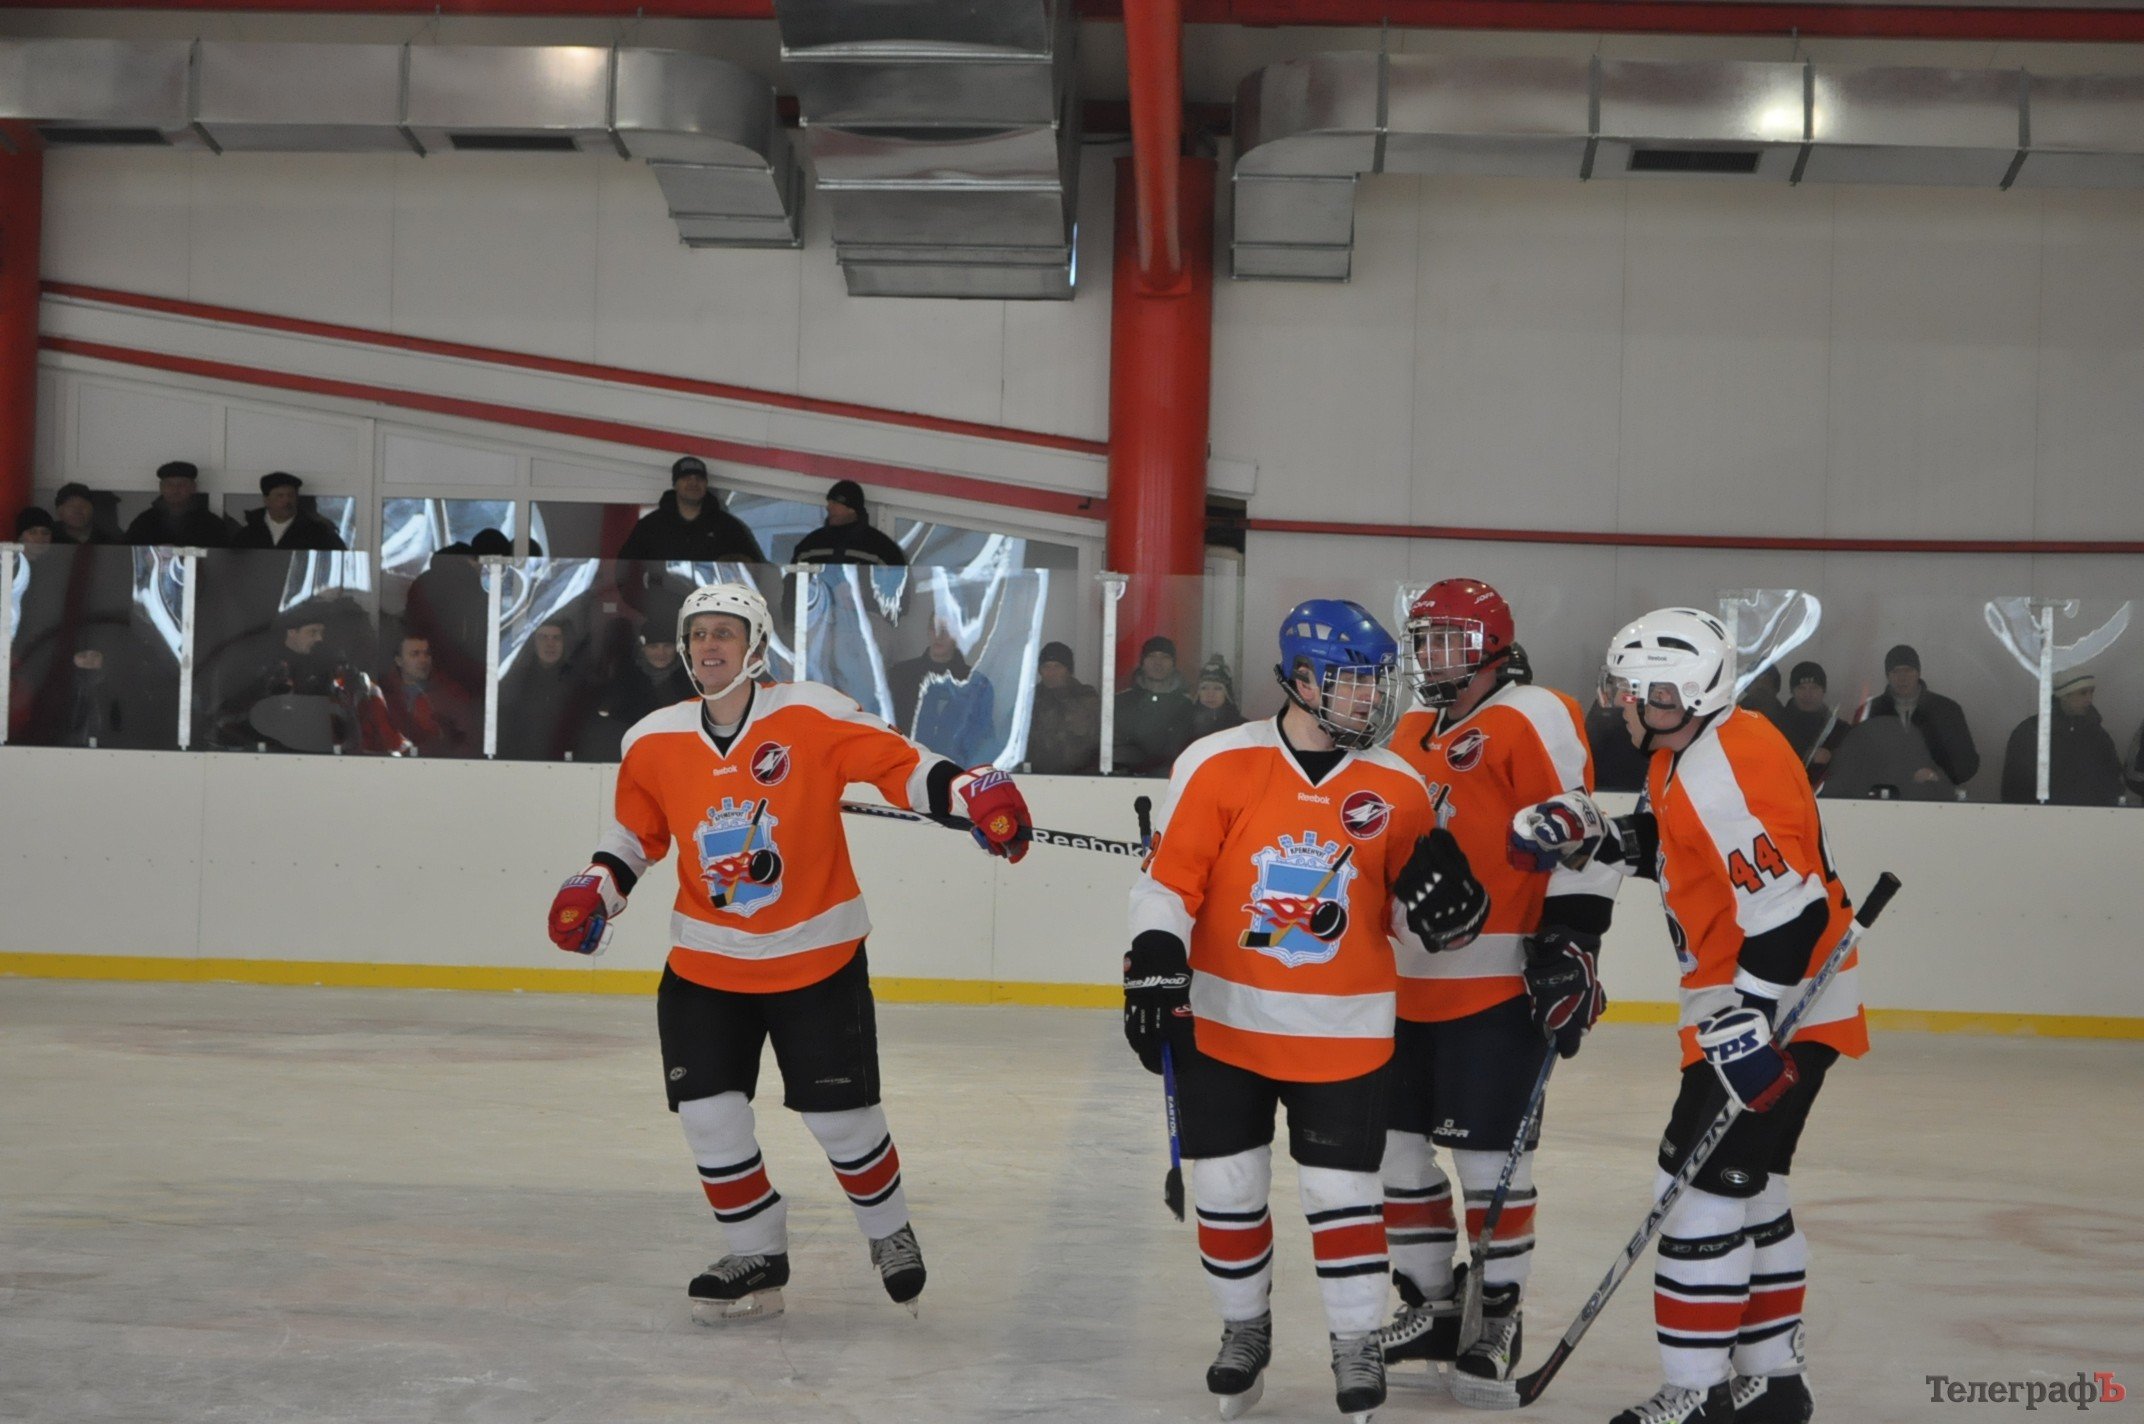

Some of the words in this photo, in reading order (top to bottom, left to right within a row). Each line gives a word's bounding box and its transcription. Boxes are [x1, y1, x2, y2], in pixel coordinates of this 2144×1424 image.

[1297, 792, 1331, 805] Reebok
[1031, 829, 1144, 858] Reebok
[1728, 832, 1790, 895] 44
[1167, 1095, 1177, 1137] EASTON
[1433, 1126, 1469, 1138] JOFA
[1626, 1106, 1733, 1260] EASTON
